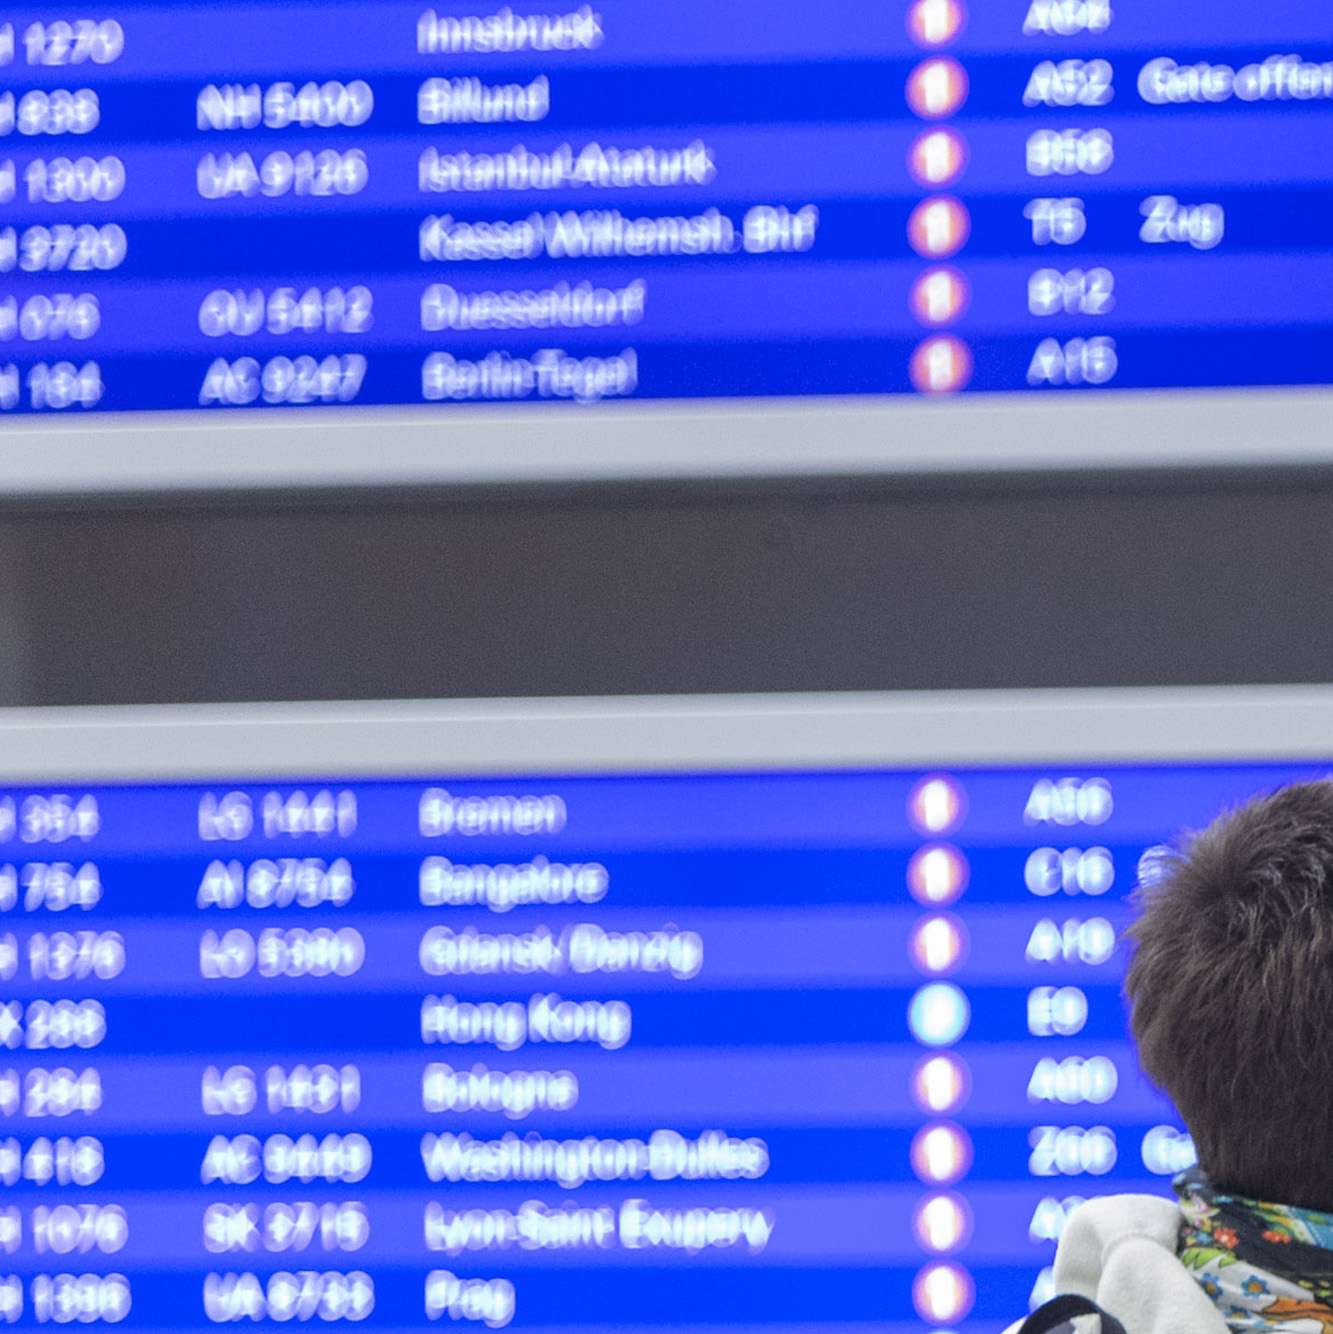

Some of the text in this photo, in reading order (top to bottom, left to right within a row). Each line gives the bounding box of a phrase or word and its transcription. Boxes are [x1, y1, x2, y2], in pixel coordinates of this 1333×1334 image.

[419, 9, 601, 50] Innsbruck
[419, 77, 548, 123] Billund
[1139, 59, 1235, 102] Gate
[198, 86, 260, 128] NH
[199, 154, 258, 197] UA
[421, 215, 542, 259] Kassel
[1141, 197, 1223, 248] Zug
[423, 283, 643, 329] Duesseldorf
[421, 790, 565, 835] Bremen
[420, 857, 607, 912] Bangalore
[422, 994, 630, 1050] Hong Kong
[424, 1064, 577, 1117] Bologna
[426, 1271, 514, 1327] Prag
